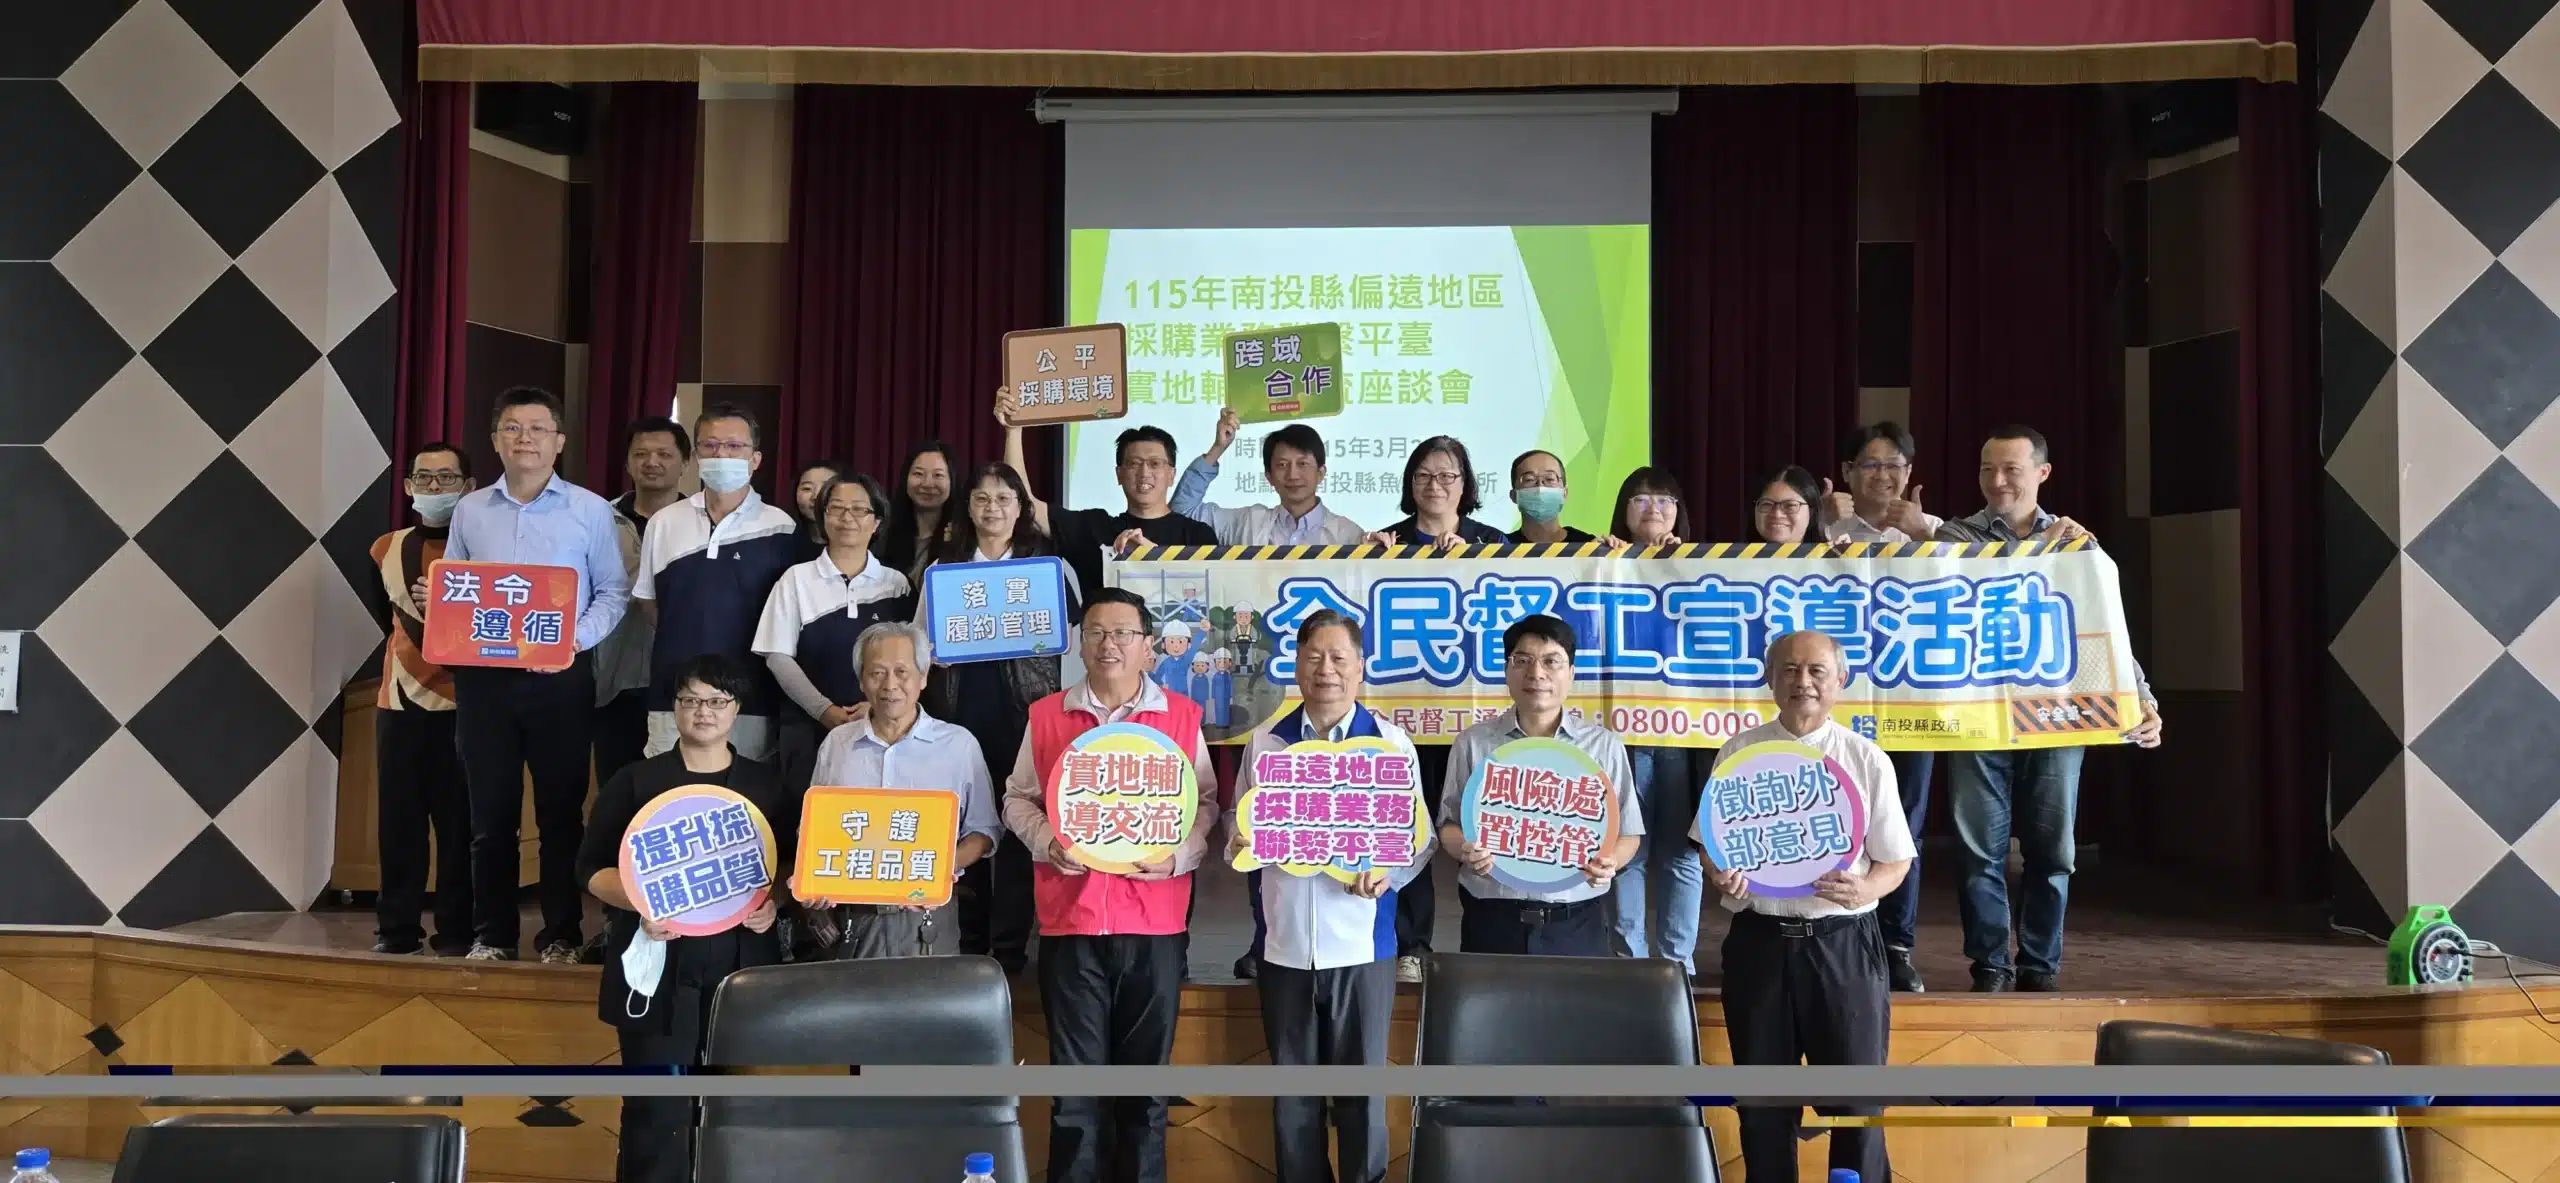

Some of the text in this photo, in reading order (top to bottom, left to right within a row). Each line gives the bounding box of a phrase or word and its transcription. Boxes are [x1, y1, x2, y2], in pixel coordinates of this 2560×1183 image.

[1124, 273, 1504, 311] 115年南投縣偏遠地區
[1127, 321, 1432, 357] 採購業平臺
[1234, 334, 1302, 369] 跨域
[1036, 344, 1095, 373] 公平
[1018, 375, 1114, 407] 採購環境
[1128, 369, 1473, 405] 實地輔座談會
[1263, 365, 1333, 398] 合作
[441, 569, 533, 606] 法令
[961, 577, 1030, 608] 落實
[471, 607, 564, 645] 遵循
[945, 609, 1052, 643] 履約管理
[1262, 571, 2078, 690] 全民督工宣導活動
[1882, 718, 1961, 732] 南投縣政府
[1063, 750, 1184, 797] 實地輔
[1253, 750, 1416, 790] 偏遠地區
[1252, 789, 1417, 828] 採購業務
[1480, 760, 1606, 821] 風險處
[1709, 761, 1840, 823] 徵詢外
[628, 802, 756, 876] 提升採
[841, 809, 921, 843] 守護
[1063, 800, 1183, 846] 導交流
[1477, 811, 1601, 870] 置控管
[1722, 811, 1852, 872] 部意見
[813, 848, 937, 882] 工程品質
[1252, 829, 1416, 868] 聯繫平臺
[643, 847, 772, 920] 購品質
